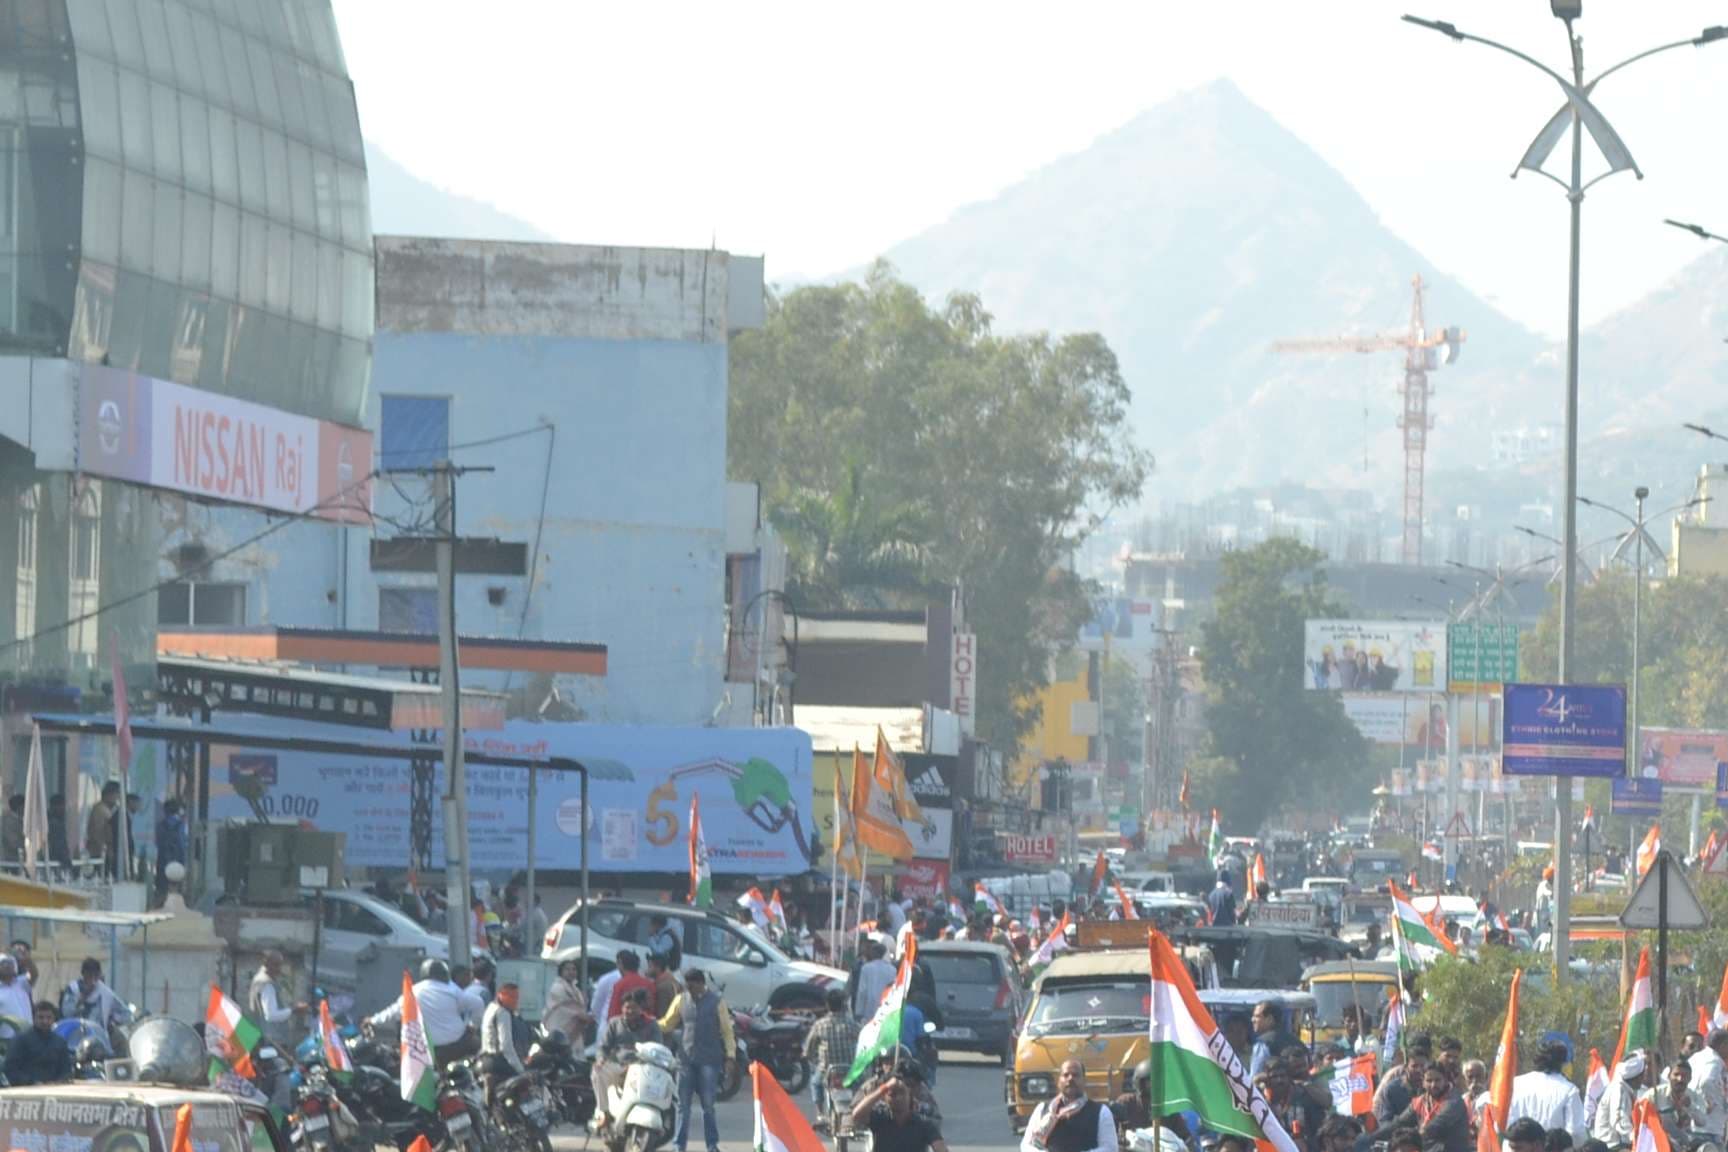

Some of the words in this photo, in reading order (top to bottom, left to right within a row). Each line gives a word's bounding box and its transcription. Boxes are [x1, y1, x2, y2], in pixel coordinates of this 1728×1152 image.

[174, 404, 266, 499] NISSAN
[275, 433, 304, 508] Raj
[955, 637, 972, 716] HOTE
[911, 783, 950, 797] adidas
[1007, 836, 1052, 853] HOTEL
